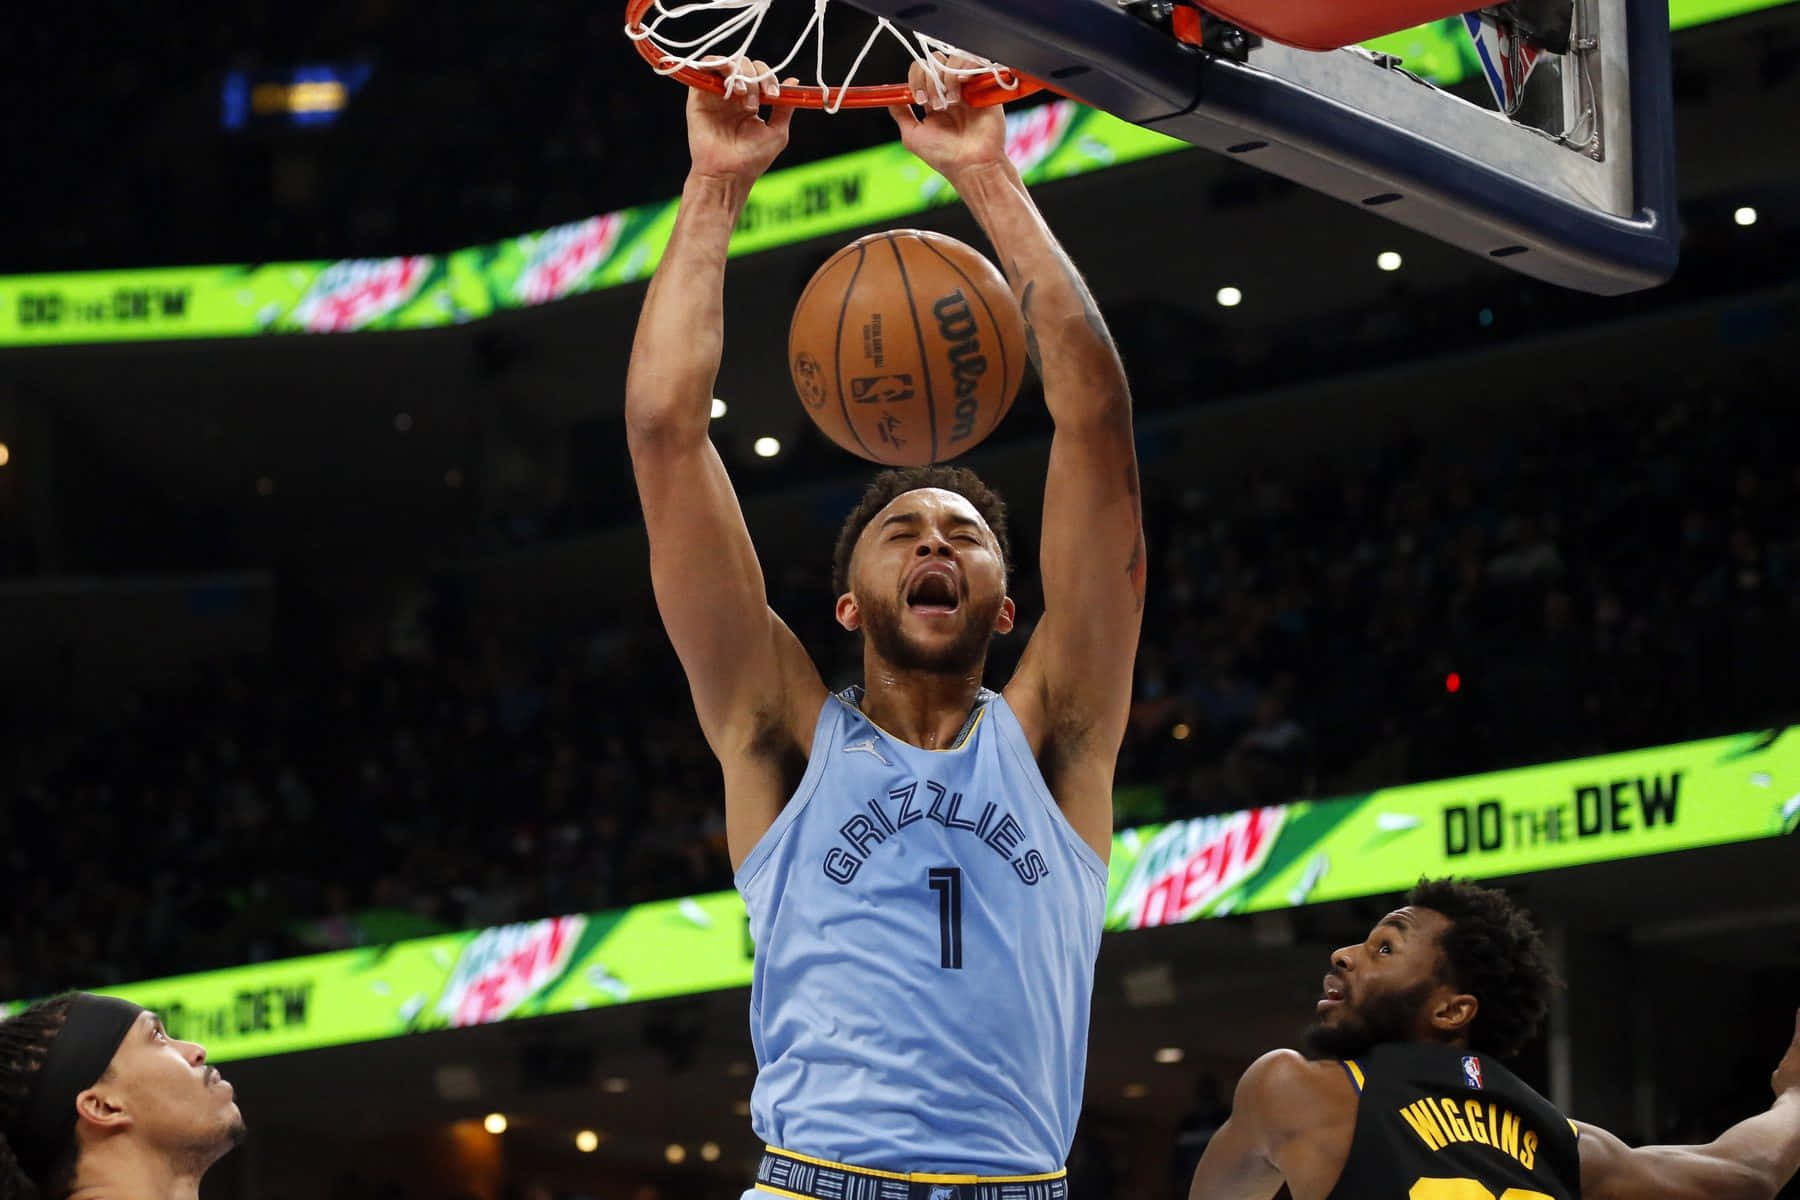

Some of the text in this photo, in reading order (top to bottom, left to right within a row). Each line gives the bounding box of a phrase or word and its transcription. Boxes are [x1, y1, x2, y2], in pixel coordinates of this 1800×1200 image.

[933, 287, 989, 443] Wilson
[822, 779, 1050, 887] GRIZZLIES
[1444, 770, 1682, 858] DO THE DEW
[928, 867, 962, 969] 1
[234, 978, 315, 1034] DEW
[1399, 1096, 1539, 1170] WIGGINS
